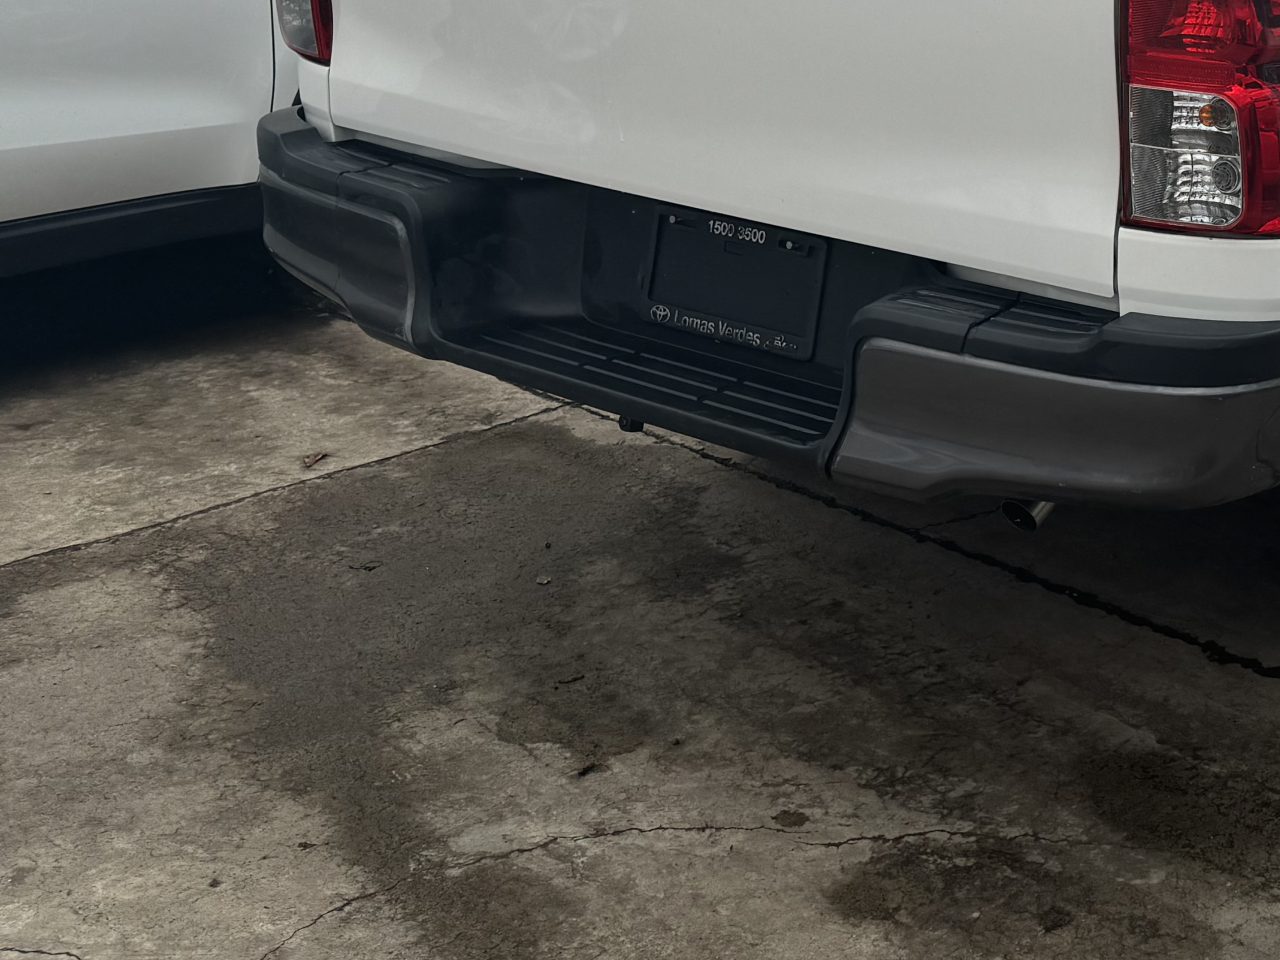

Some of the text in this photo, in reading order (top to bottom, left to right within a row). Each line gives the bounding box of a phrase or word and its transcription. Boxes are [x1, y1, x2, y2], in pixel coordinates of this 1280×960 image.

[708, 219, 767, 244] 1500 3500
[674, 309, 716, 334] Lomas
[718, 320, 761, 346] Verdes
